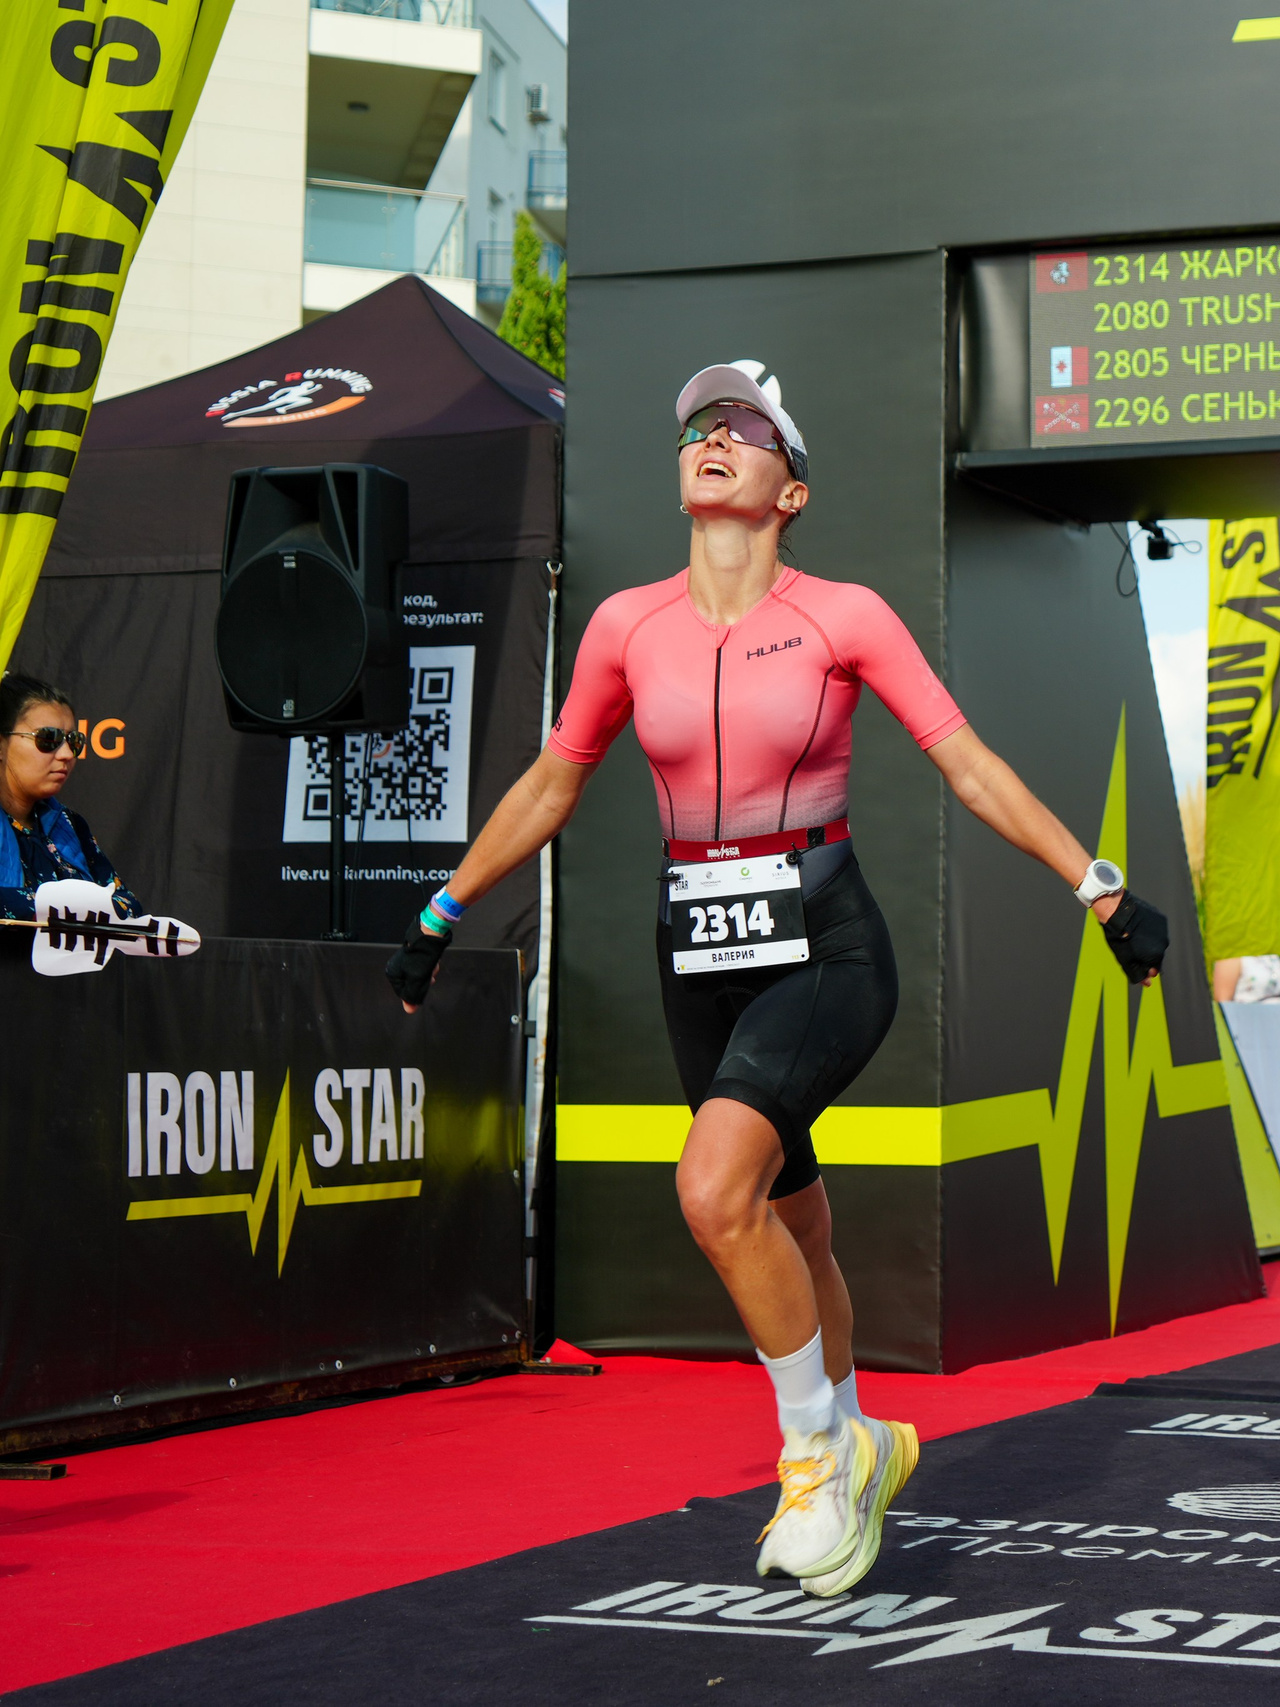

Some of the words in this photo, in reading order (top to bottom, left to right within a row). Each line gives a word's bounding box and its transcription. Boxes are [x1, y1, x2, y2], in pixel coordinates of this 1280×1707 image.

[1093, 253, 1170, 287] 2314
[1093, 299, 1170, 333] 2080
[1094, 346, 1170, 381] 2805
[1094, 395, 1170, 428] 2296
[746, 637, 802, 660] HUUB
[281, 865, 457, 884] live.ruiarunning.co
[688, 899, 775, 944] 2314
[711, 949, 755, 963] ВАЛЕРИЯ
[127, 1070, 254, 1178] IRON
[313, 1067, 426, 1168] STAR
[570, 1581, 958, 1628] IRON
